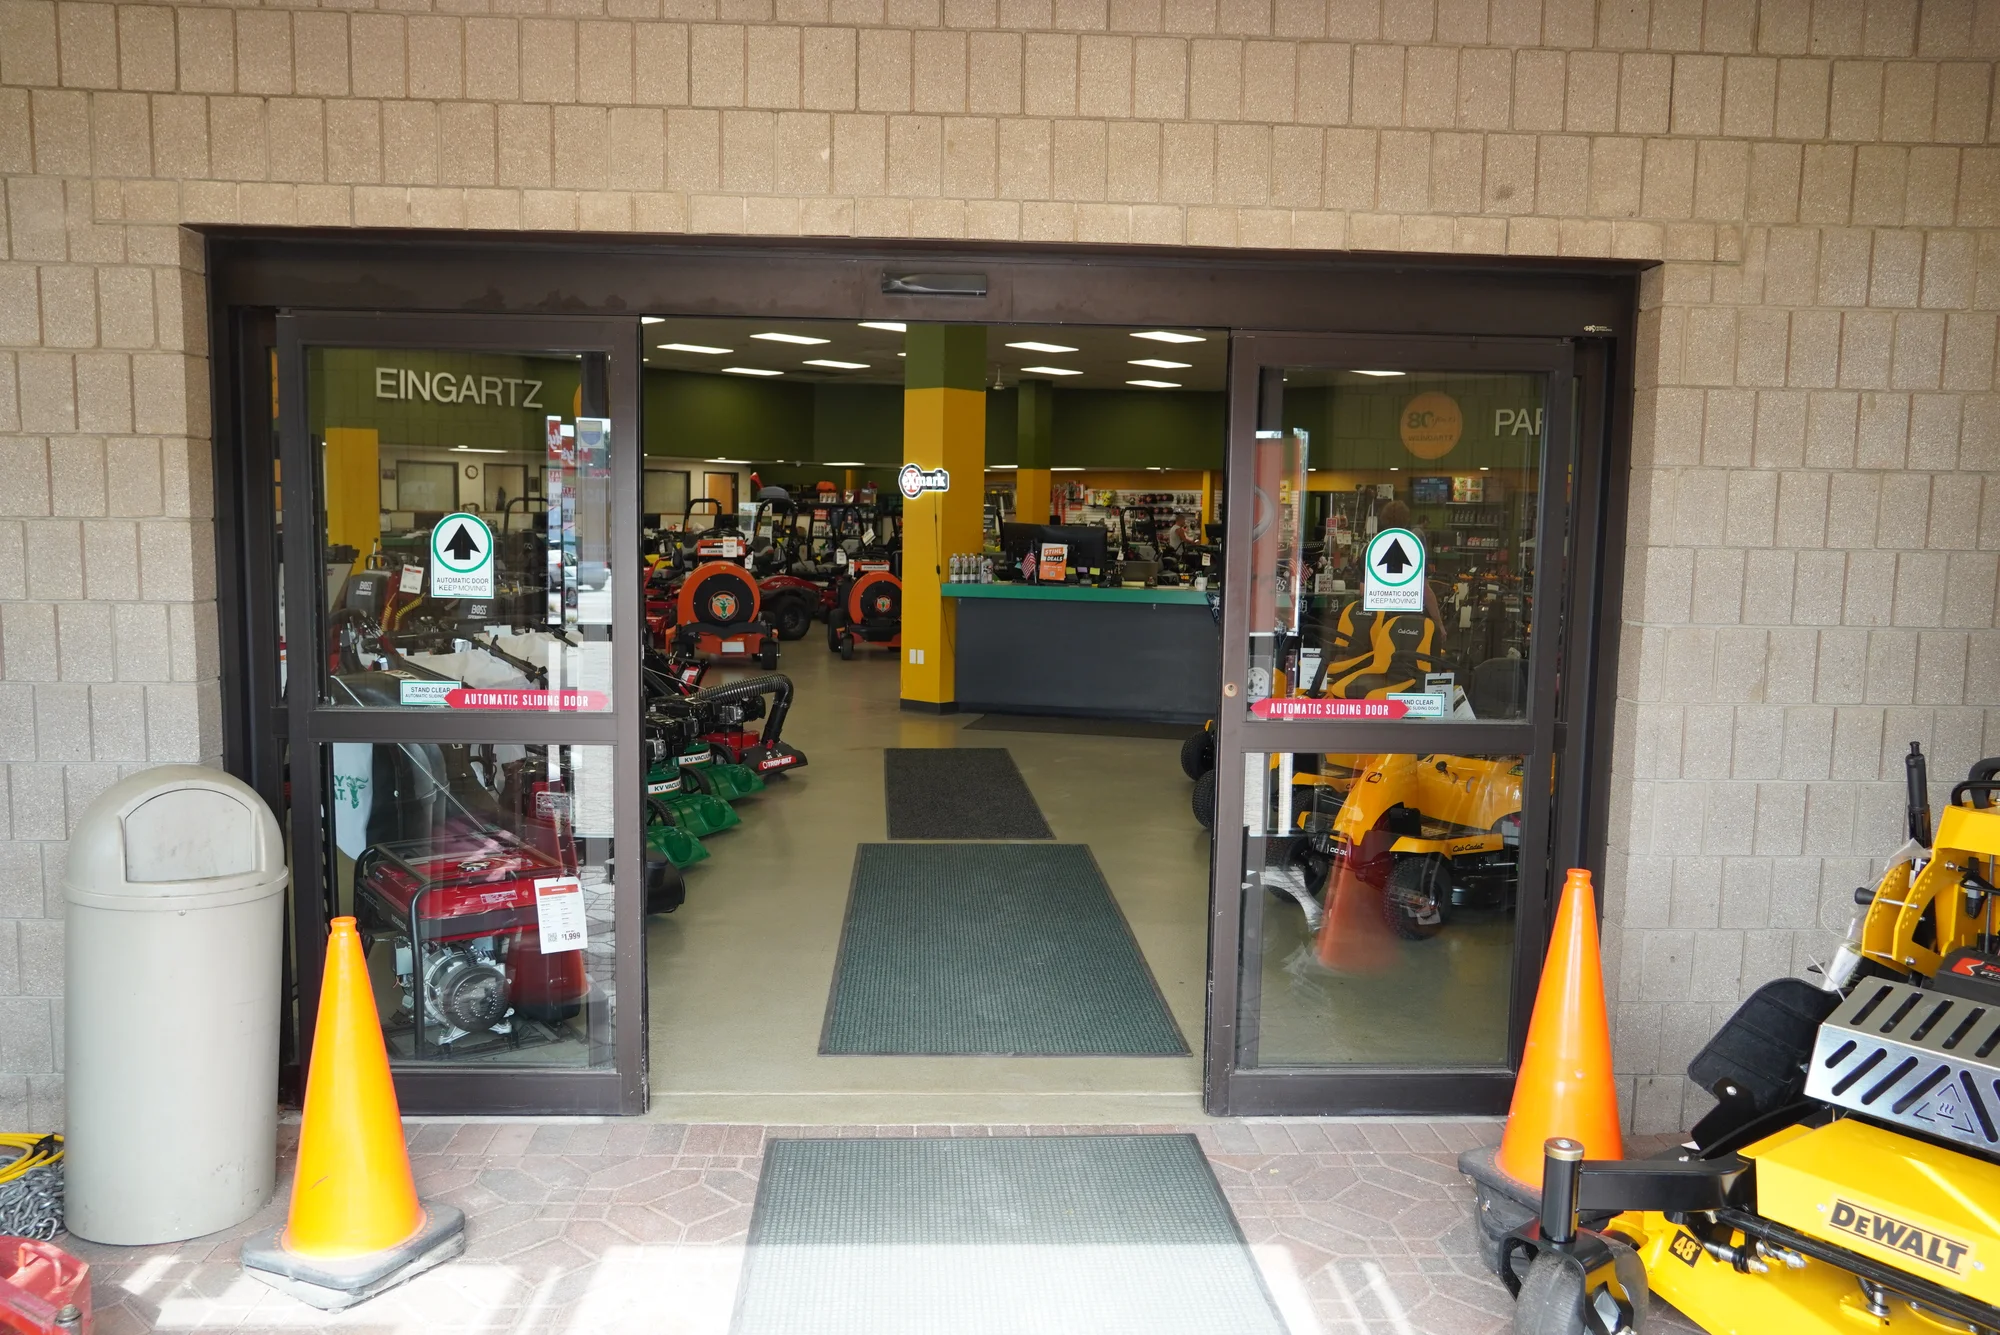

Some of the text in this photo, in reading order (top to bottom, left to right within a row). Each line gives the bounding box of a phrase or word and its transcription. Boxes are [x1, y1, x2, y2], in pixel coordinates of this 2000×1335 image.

[375, 366, 543, 409] EINGARTZ
[464, 693, 589, 707] AUTOMATIC SLIDING DOOR
[1270, 702, 1389, 716] AUTOMATIC SLIDING DOOR
[1453, 842, 1484, 852] Cub Cadet
[561, 931, 581, 941] $1,999
